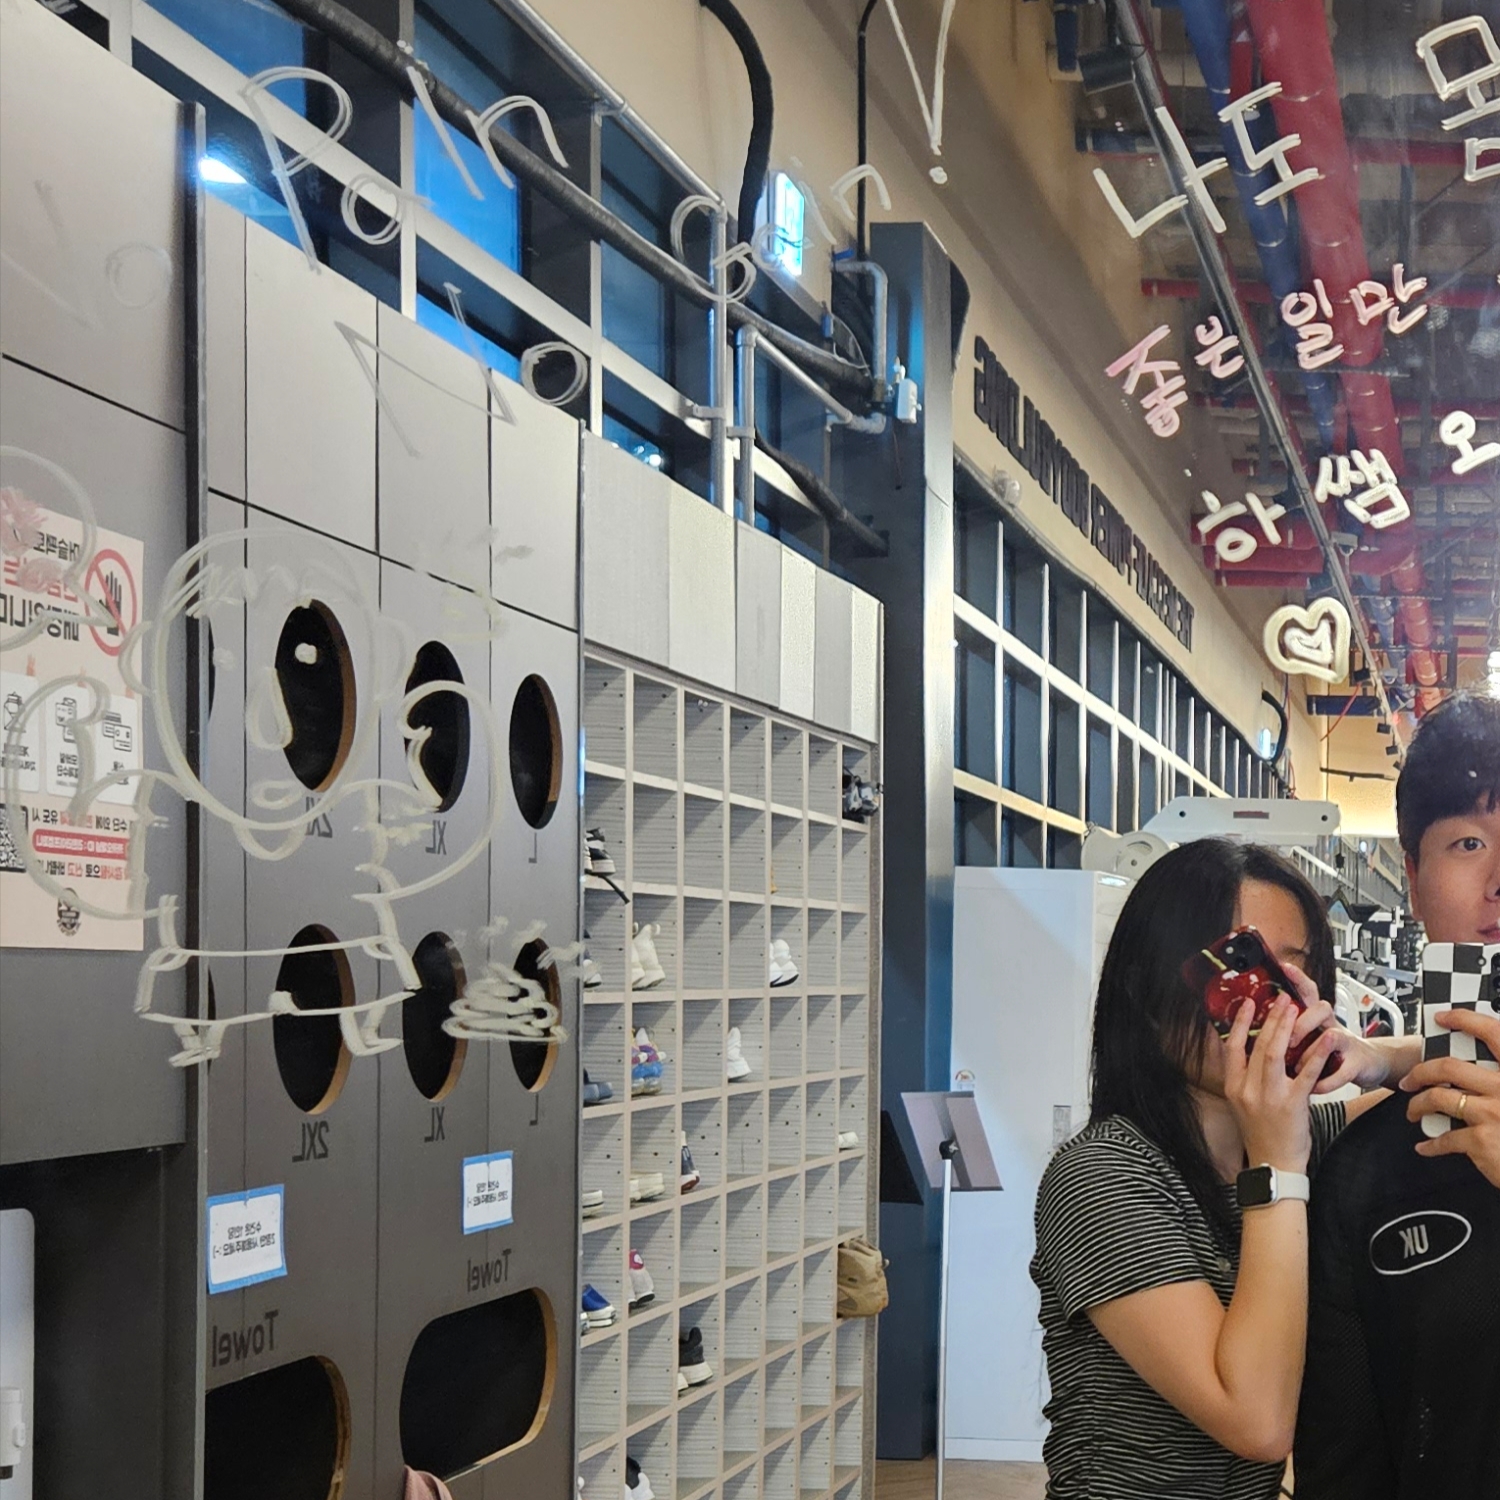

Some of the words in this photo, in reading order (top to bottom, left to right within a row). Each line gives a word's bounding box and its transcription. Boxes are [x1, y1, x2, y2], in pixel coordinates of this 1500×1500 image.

[1093, 81, 1320, 238] 나도
[1105, 314, 1246, 438] 좋은
[1282, 263, 1429, 370] 일만
